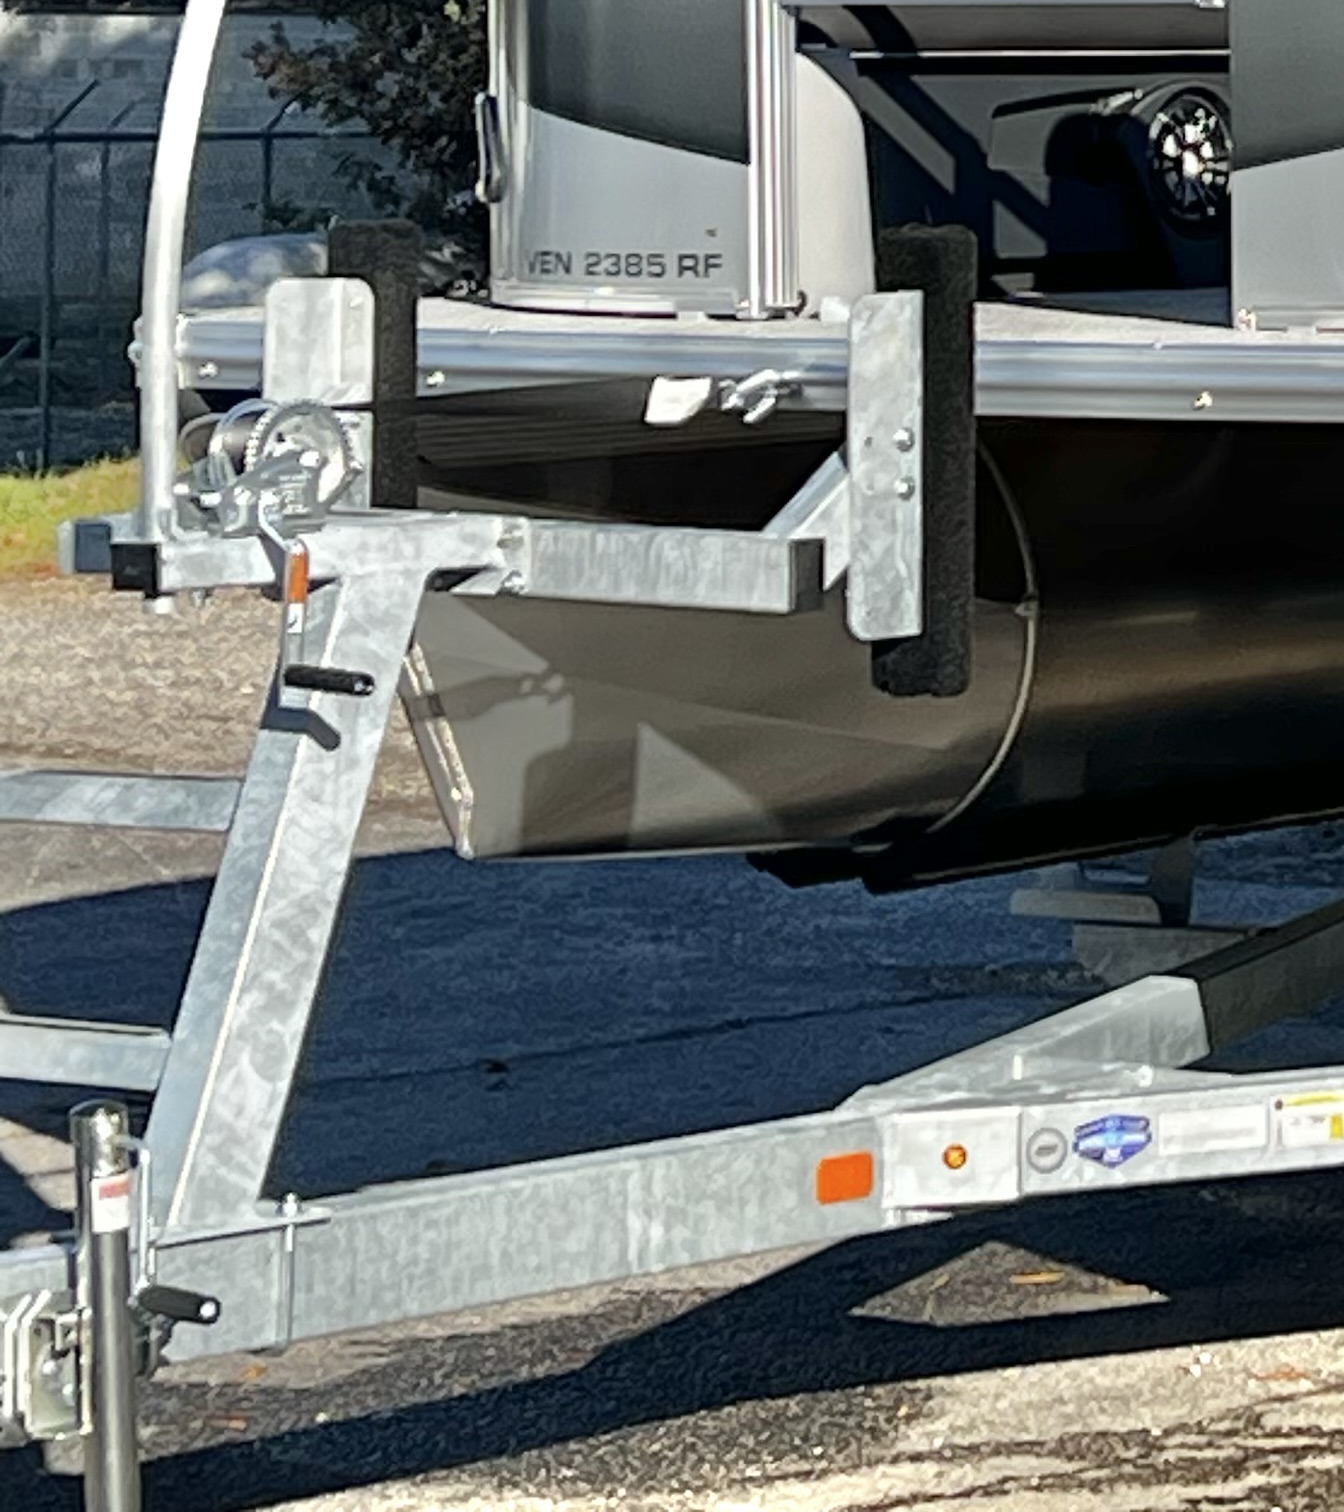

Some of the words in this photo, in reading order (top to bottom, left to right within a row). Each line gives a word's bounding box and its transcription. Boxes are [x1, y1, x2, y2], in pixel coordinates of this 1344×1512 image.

[527, 251, 572, 275] VEN
[584, 252, 666, 278] 2385
[677, 253, 722, 278] RF
